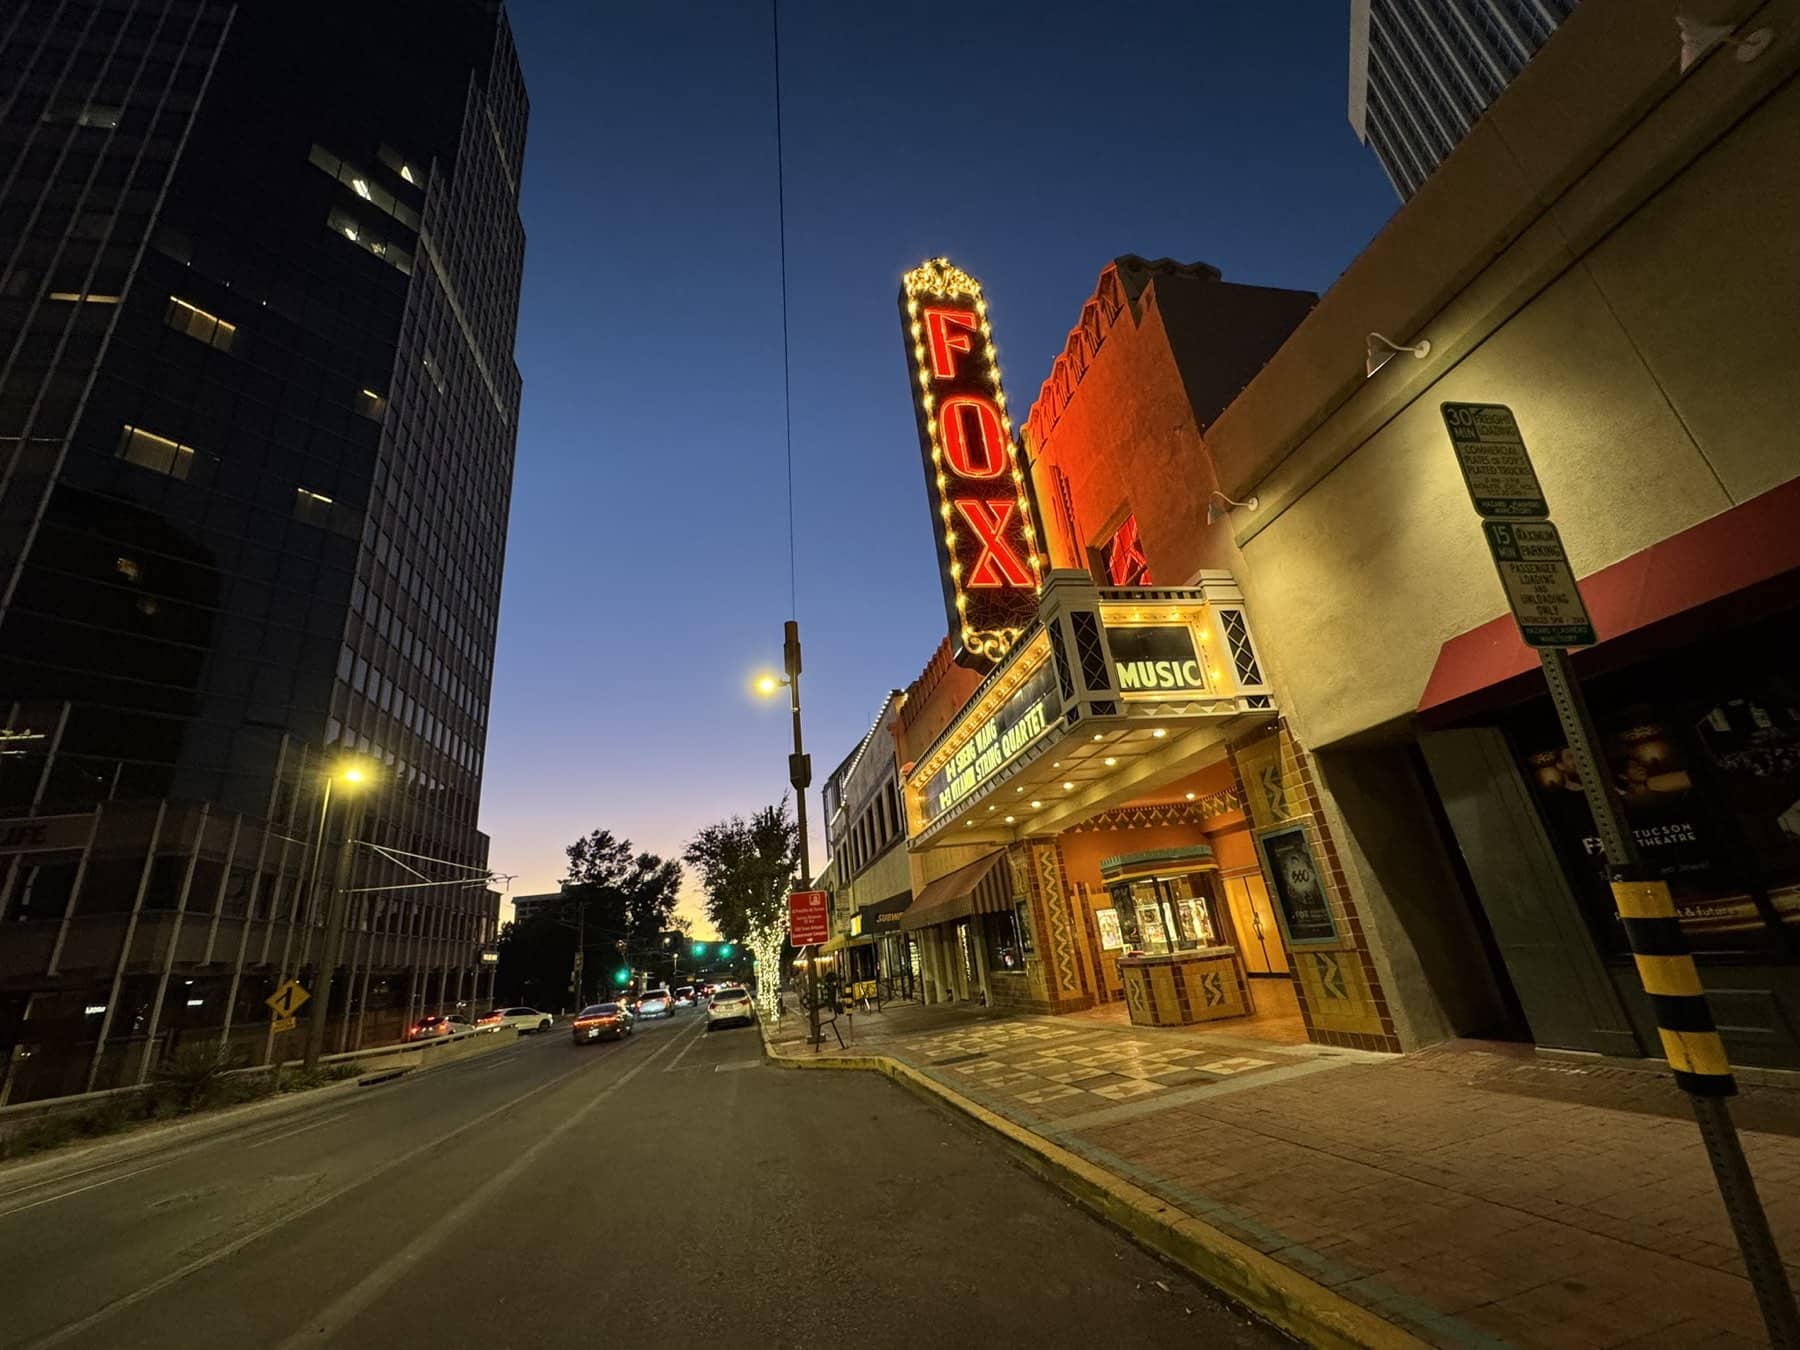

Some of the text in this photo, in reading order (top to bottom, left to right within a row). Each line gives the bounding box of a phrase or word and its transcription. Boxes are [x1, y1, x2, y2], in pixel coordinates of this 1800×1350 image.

[1447, 408, 1472, 426] 30
[924, 308, 1036, 589] FOX
[1491, 525, 1511, 545] 15
[1520, 544, 1561, 557] PARKING
[1510, 563, 1557, 573] PASSENGER
[1520, 574, 1556, 585] LOADING
[1520, 593, 1569, 604] UNLOADING
[1115, 660, 1202, 689] MUSIC
[975, 742, 1002, 781] STRING
[1001, 702, 1046, 758] QUARTET
[1632, 823, 1692, 839] TUCSON
[1636, 832, 1697, 848] THEATRE
